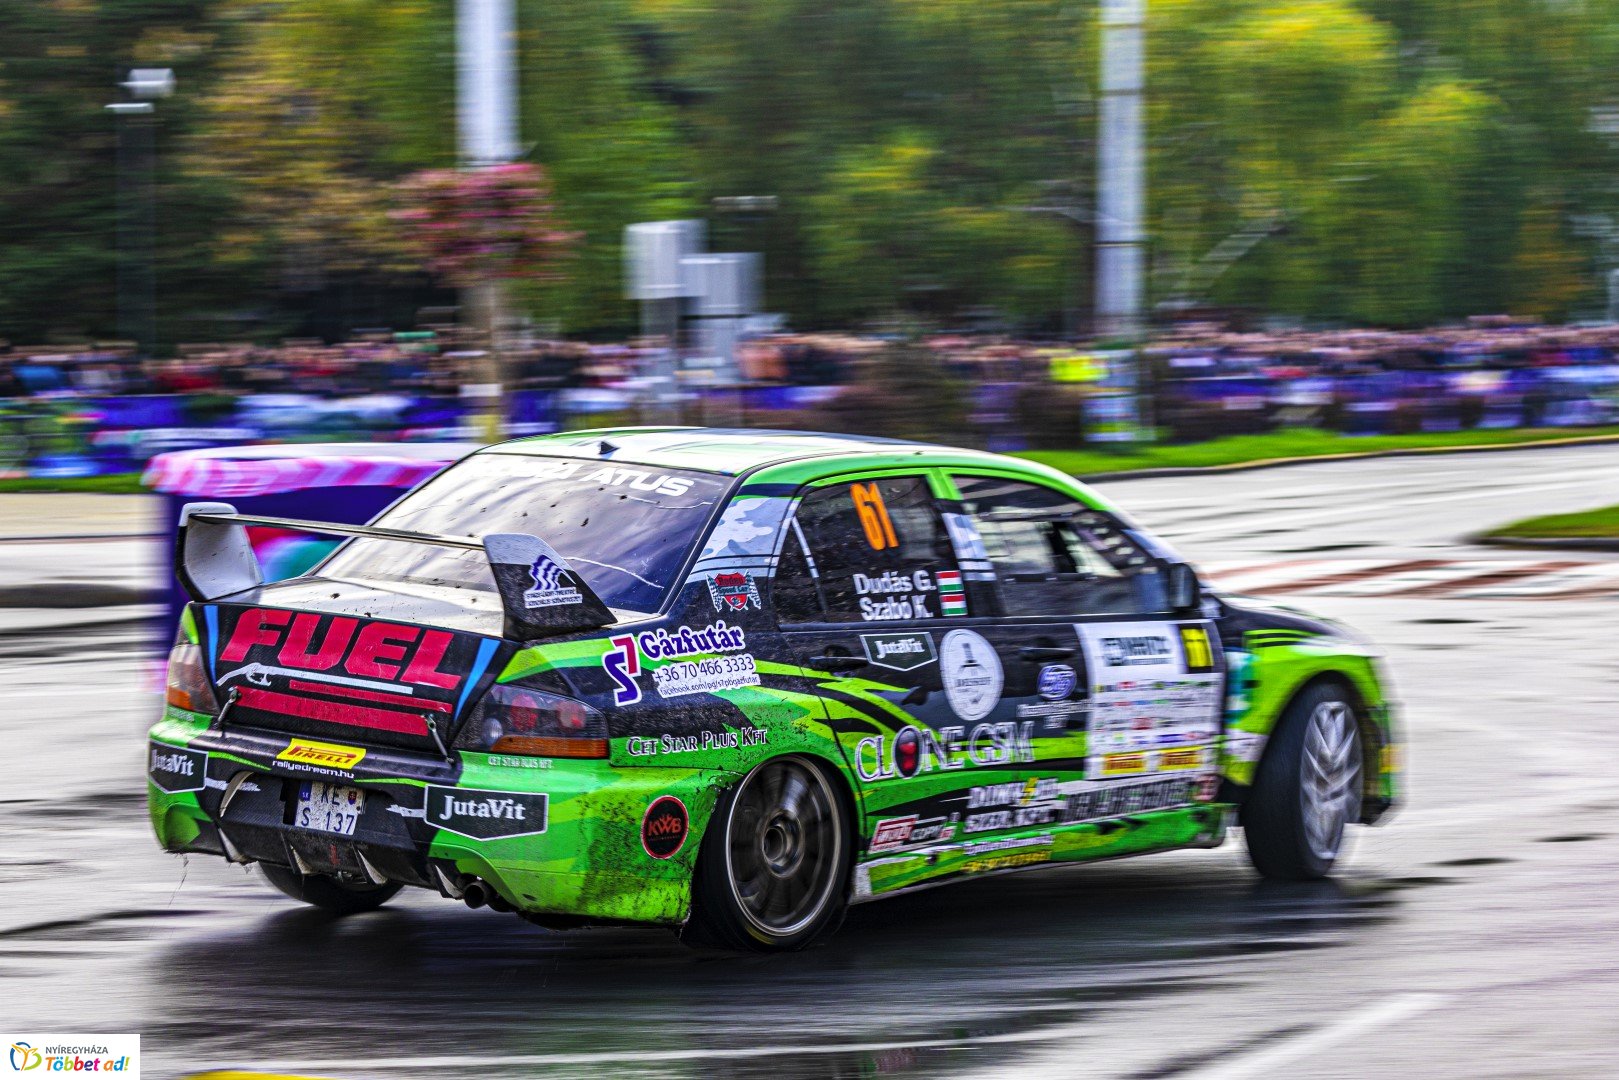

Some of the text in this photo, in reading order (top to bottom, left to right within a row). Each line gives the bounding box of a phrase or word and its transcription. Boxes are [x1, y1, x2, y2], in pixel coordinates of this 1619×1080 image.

[849, 482, 899, 551] 61
[853, 569, 937, 595] Dudás G.
[859, 594, 934, 621] Szabó K.
[219, 607, 462, 691] FUEL
[639, 622, 744, 659] Gázfutár
[875, 638, 926, 659] JutaVit
[655, 656, 755, 684] +36 70 466 3333
[287, 745, 357, 764] PIRELLI
[627, 726, 769, 757] CET STAR PLUS KFT
[968, 720, 1036, 766] GSM
[150, 749, 195, 776] JutaVit
[272, 760, 355, 779] rallyedream.hu
[301, 807, 355, 834] S 137
[439, 795, 527, 821] JutaVit
[647, 814, 682, 836] KWB
